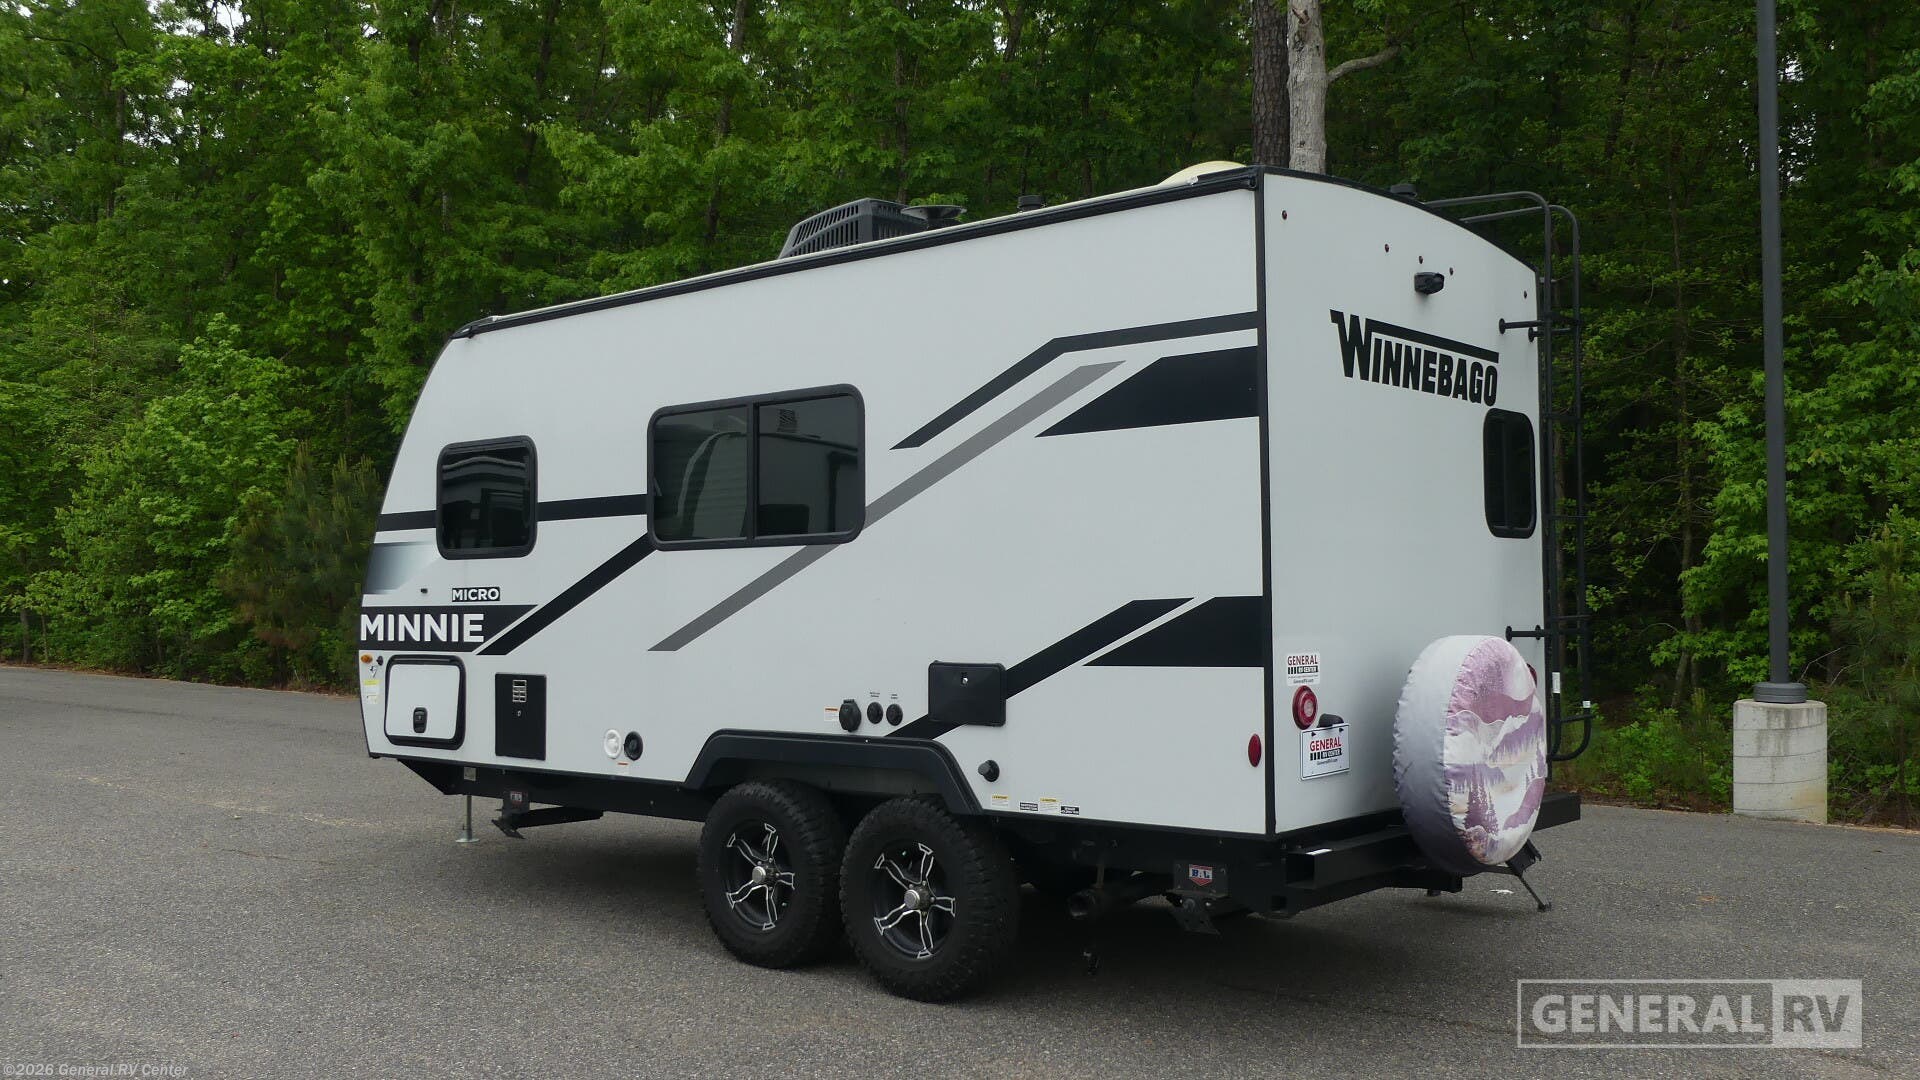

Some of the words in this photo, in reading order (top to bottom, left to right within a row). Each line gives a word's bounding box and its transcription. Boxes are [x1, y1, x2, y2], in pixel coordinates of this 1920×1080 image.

[1330, 309, 1499, 407] WINNEBAGO
[452, 588, 499, 601] MICRO
[360, 613, 485, 643] MINNIE
[1287, 654, 1318, 666] GENERAL
[1310, 737, 1342, 751] GENERAL
